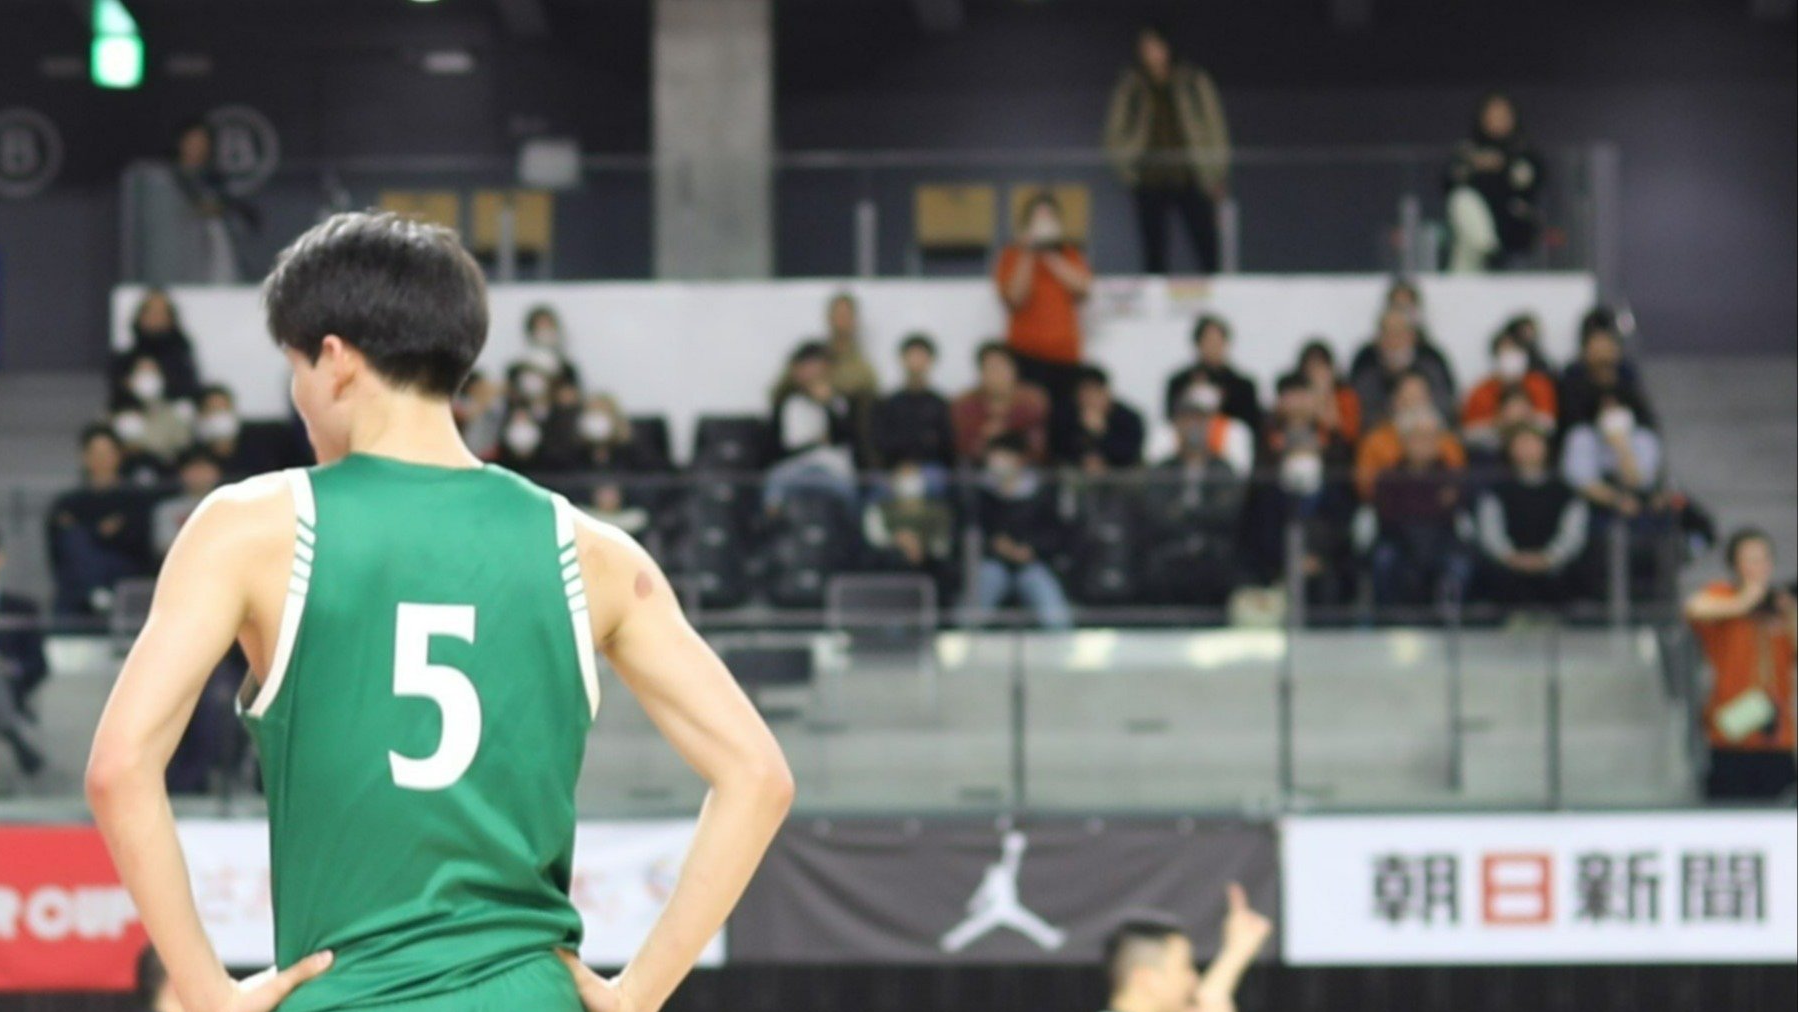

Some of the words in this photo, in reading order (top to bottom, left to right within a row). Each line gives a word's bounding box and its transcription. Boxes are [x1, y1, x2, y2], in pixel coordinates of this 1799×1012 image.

[388, 602, 482, 790] 5
[1373, 851, 1767, 926] 朝日新聞
